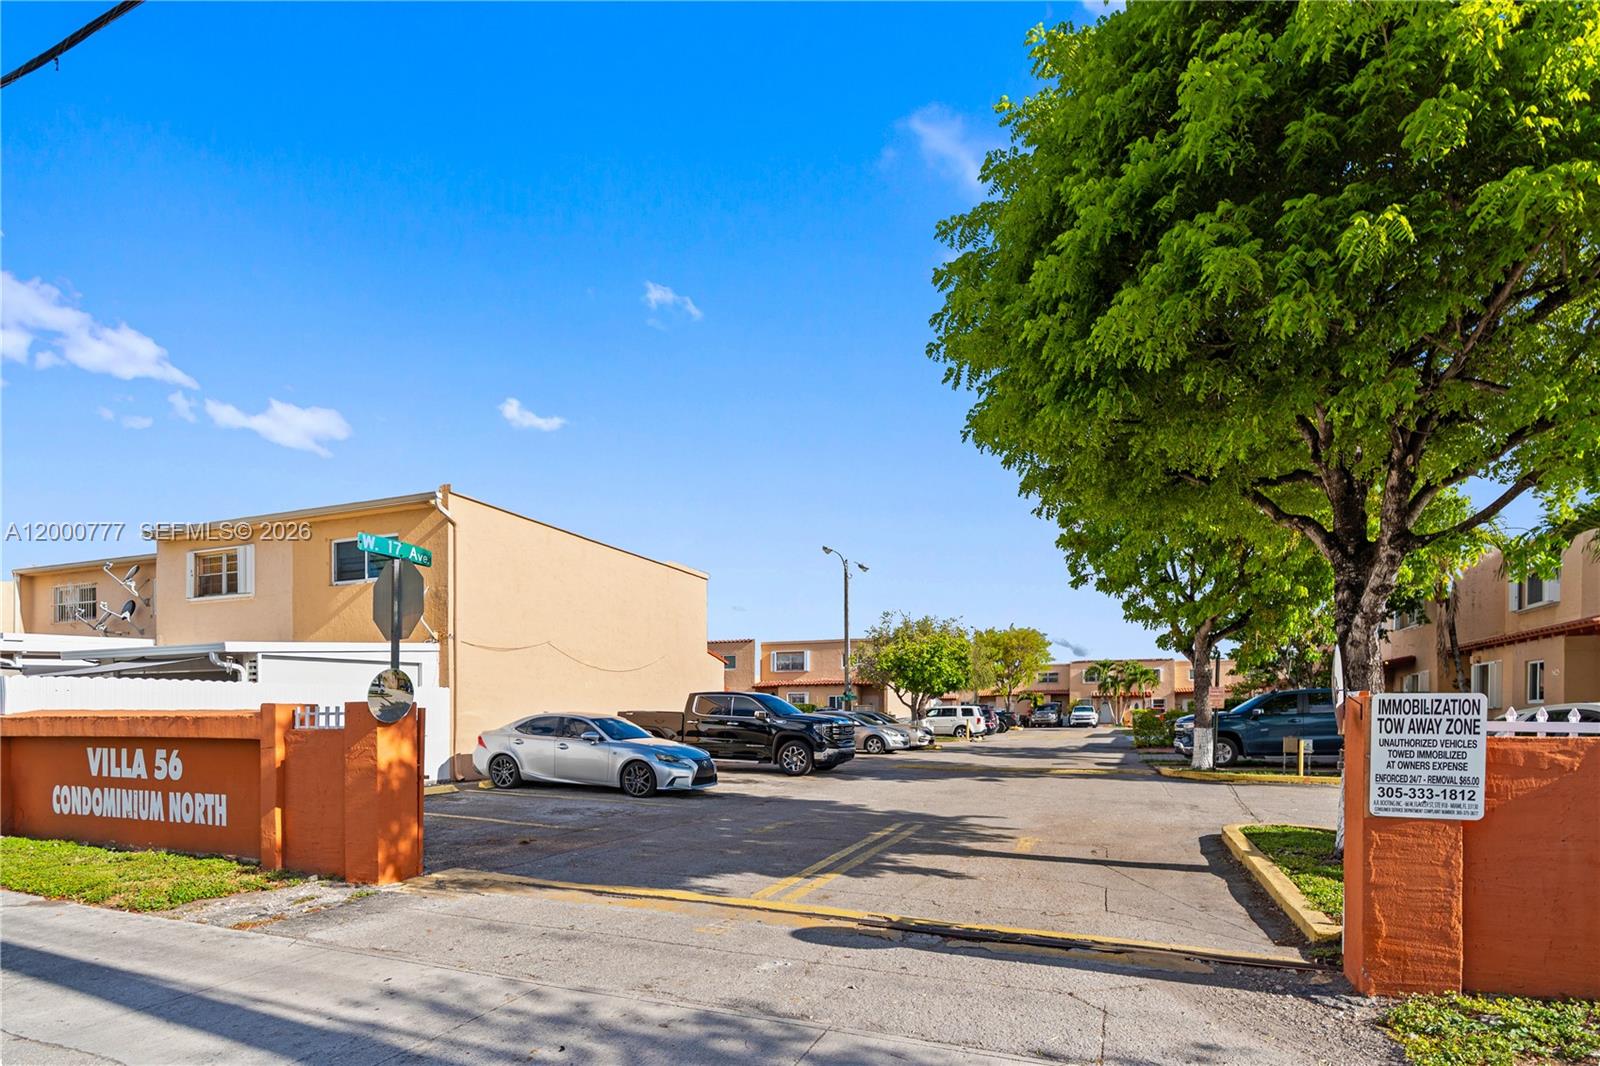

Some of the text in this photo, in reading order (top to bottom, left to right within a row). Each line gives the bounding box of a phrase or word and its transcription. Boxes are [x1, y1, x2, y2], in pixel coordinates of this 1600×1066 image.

[362, 533, 379, 551] W.
[388, 540, 400, 555] 17
[1378, 699, 1481, 716] IMMOBILIZATION
[1377, 718, 1481, 735] TOW AWAY ZONE
[1378, 738, 1478, 749] UNAUTHORIZED VEHICLES
[1388, 749, 1467, 760] TOWED IMMOBILIZED
[87, 747, 183, 781] VILLA 56
[1386, 760, 1468, 771] AT OWNERS EXPENSE
[1375, 773, 1408, 783] ENFORCED
[1409, 774, 1422, 783] 24/7
[1427, 775, 1458, 785] REMOVAL
[1459, 776, 1480, 786] $65.00
[1377, 786, 1476, 801] 305-333-1812
[52, 785, 227, 826] CONDOMINIUM NORTH
